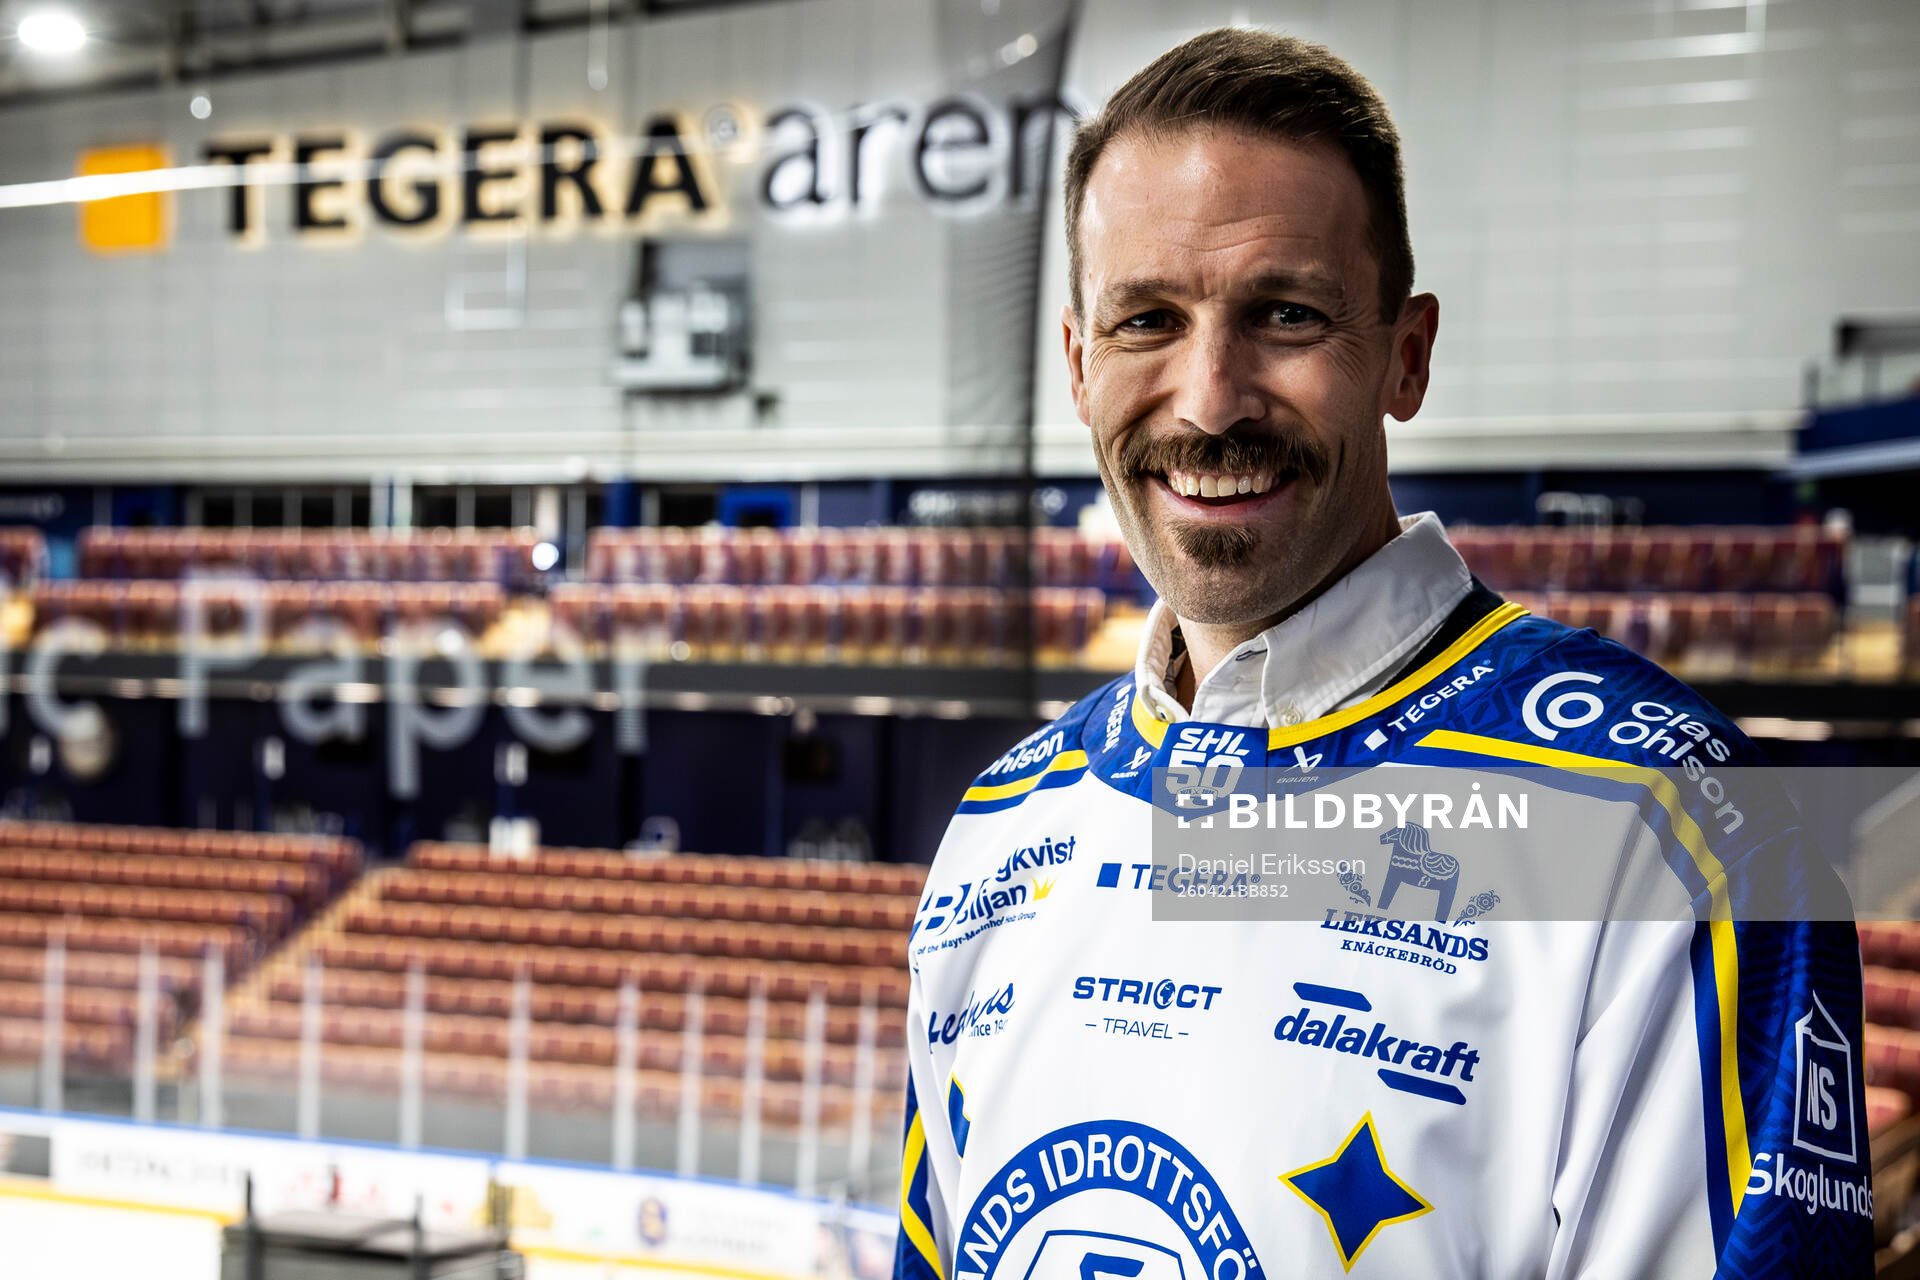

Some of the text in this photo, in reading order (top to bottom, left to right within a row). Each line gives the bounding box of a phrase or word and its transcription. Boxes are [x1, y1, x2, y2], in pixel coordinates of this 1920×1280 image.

[177, 569, 653, 798] Paper
[978, 730, 1065, 777] hlson
[1172, 727, 1250, 756] SHL
[1631, 701, 1731, 762] Clas
[1165, 749, 1245, 798] 50
[1608, 721, 1745, 835] Ohlson
[1320, 908, 1489, 962] LEKSANDS
[1340, 939, 1457, 975] KNÄCKEBRÖD
[1273, 1007, 1480, 1082] dalakraft
[1807, 1058, 1838, 1131] NS
[1745, 1152, 1874, 1221] Skoglunds
